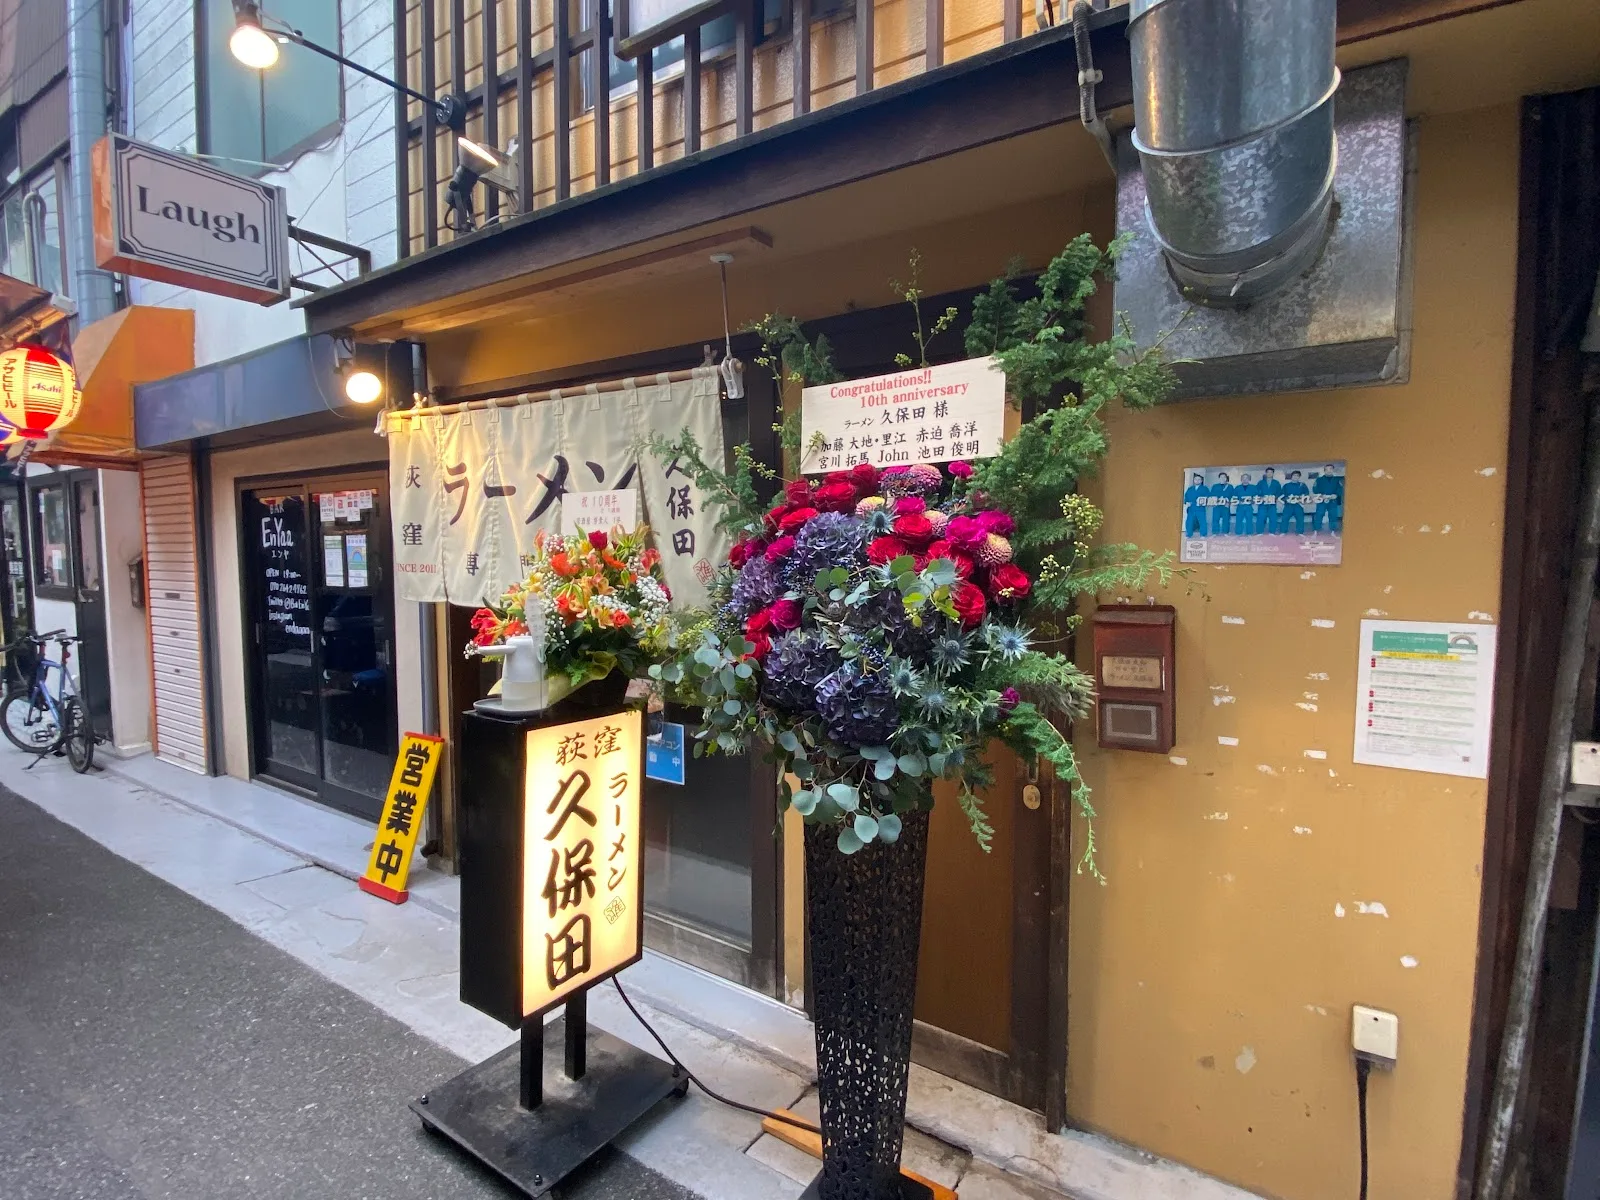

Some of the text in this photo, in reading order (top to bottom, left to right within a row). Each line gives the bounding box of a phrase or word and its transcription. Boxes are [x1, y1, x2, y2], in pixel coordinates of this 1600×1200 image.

[136, 185, 260, 244] Laugh
[32, 382, 62, 394] Asahi
[830, 370, 932, 399] Congratulations!!
[861, 382, 970, 409] 10th anniversary
[844, 400, 949, 430] ラーメン 久保田 様
[819, 440, 979, 470] 宮川 拓馬 John 池田 俊明
[820, 438, 844, 453] 加藤
[916, 426, 943, 443] 赤迫
[443, 454, 637, 526] ラーメン
[556, 725, 623, 767] 荻窪
[375, 742, 430, 884] 営業中
[608, 772, 629, 892] ラーメン
[541, 769, 598, 991] 久保田
